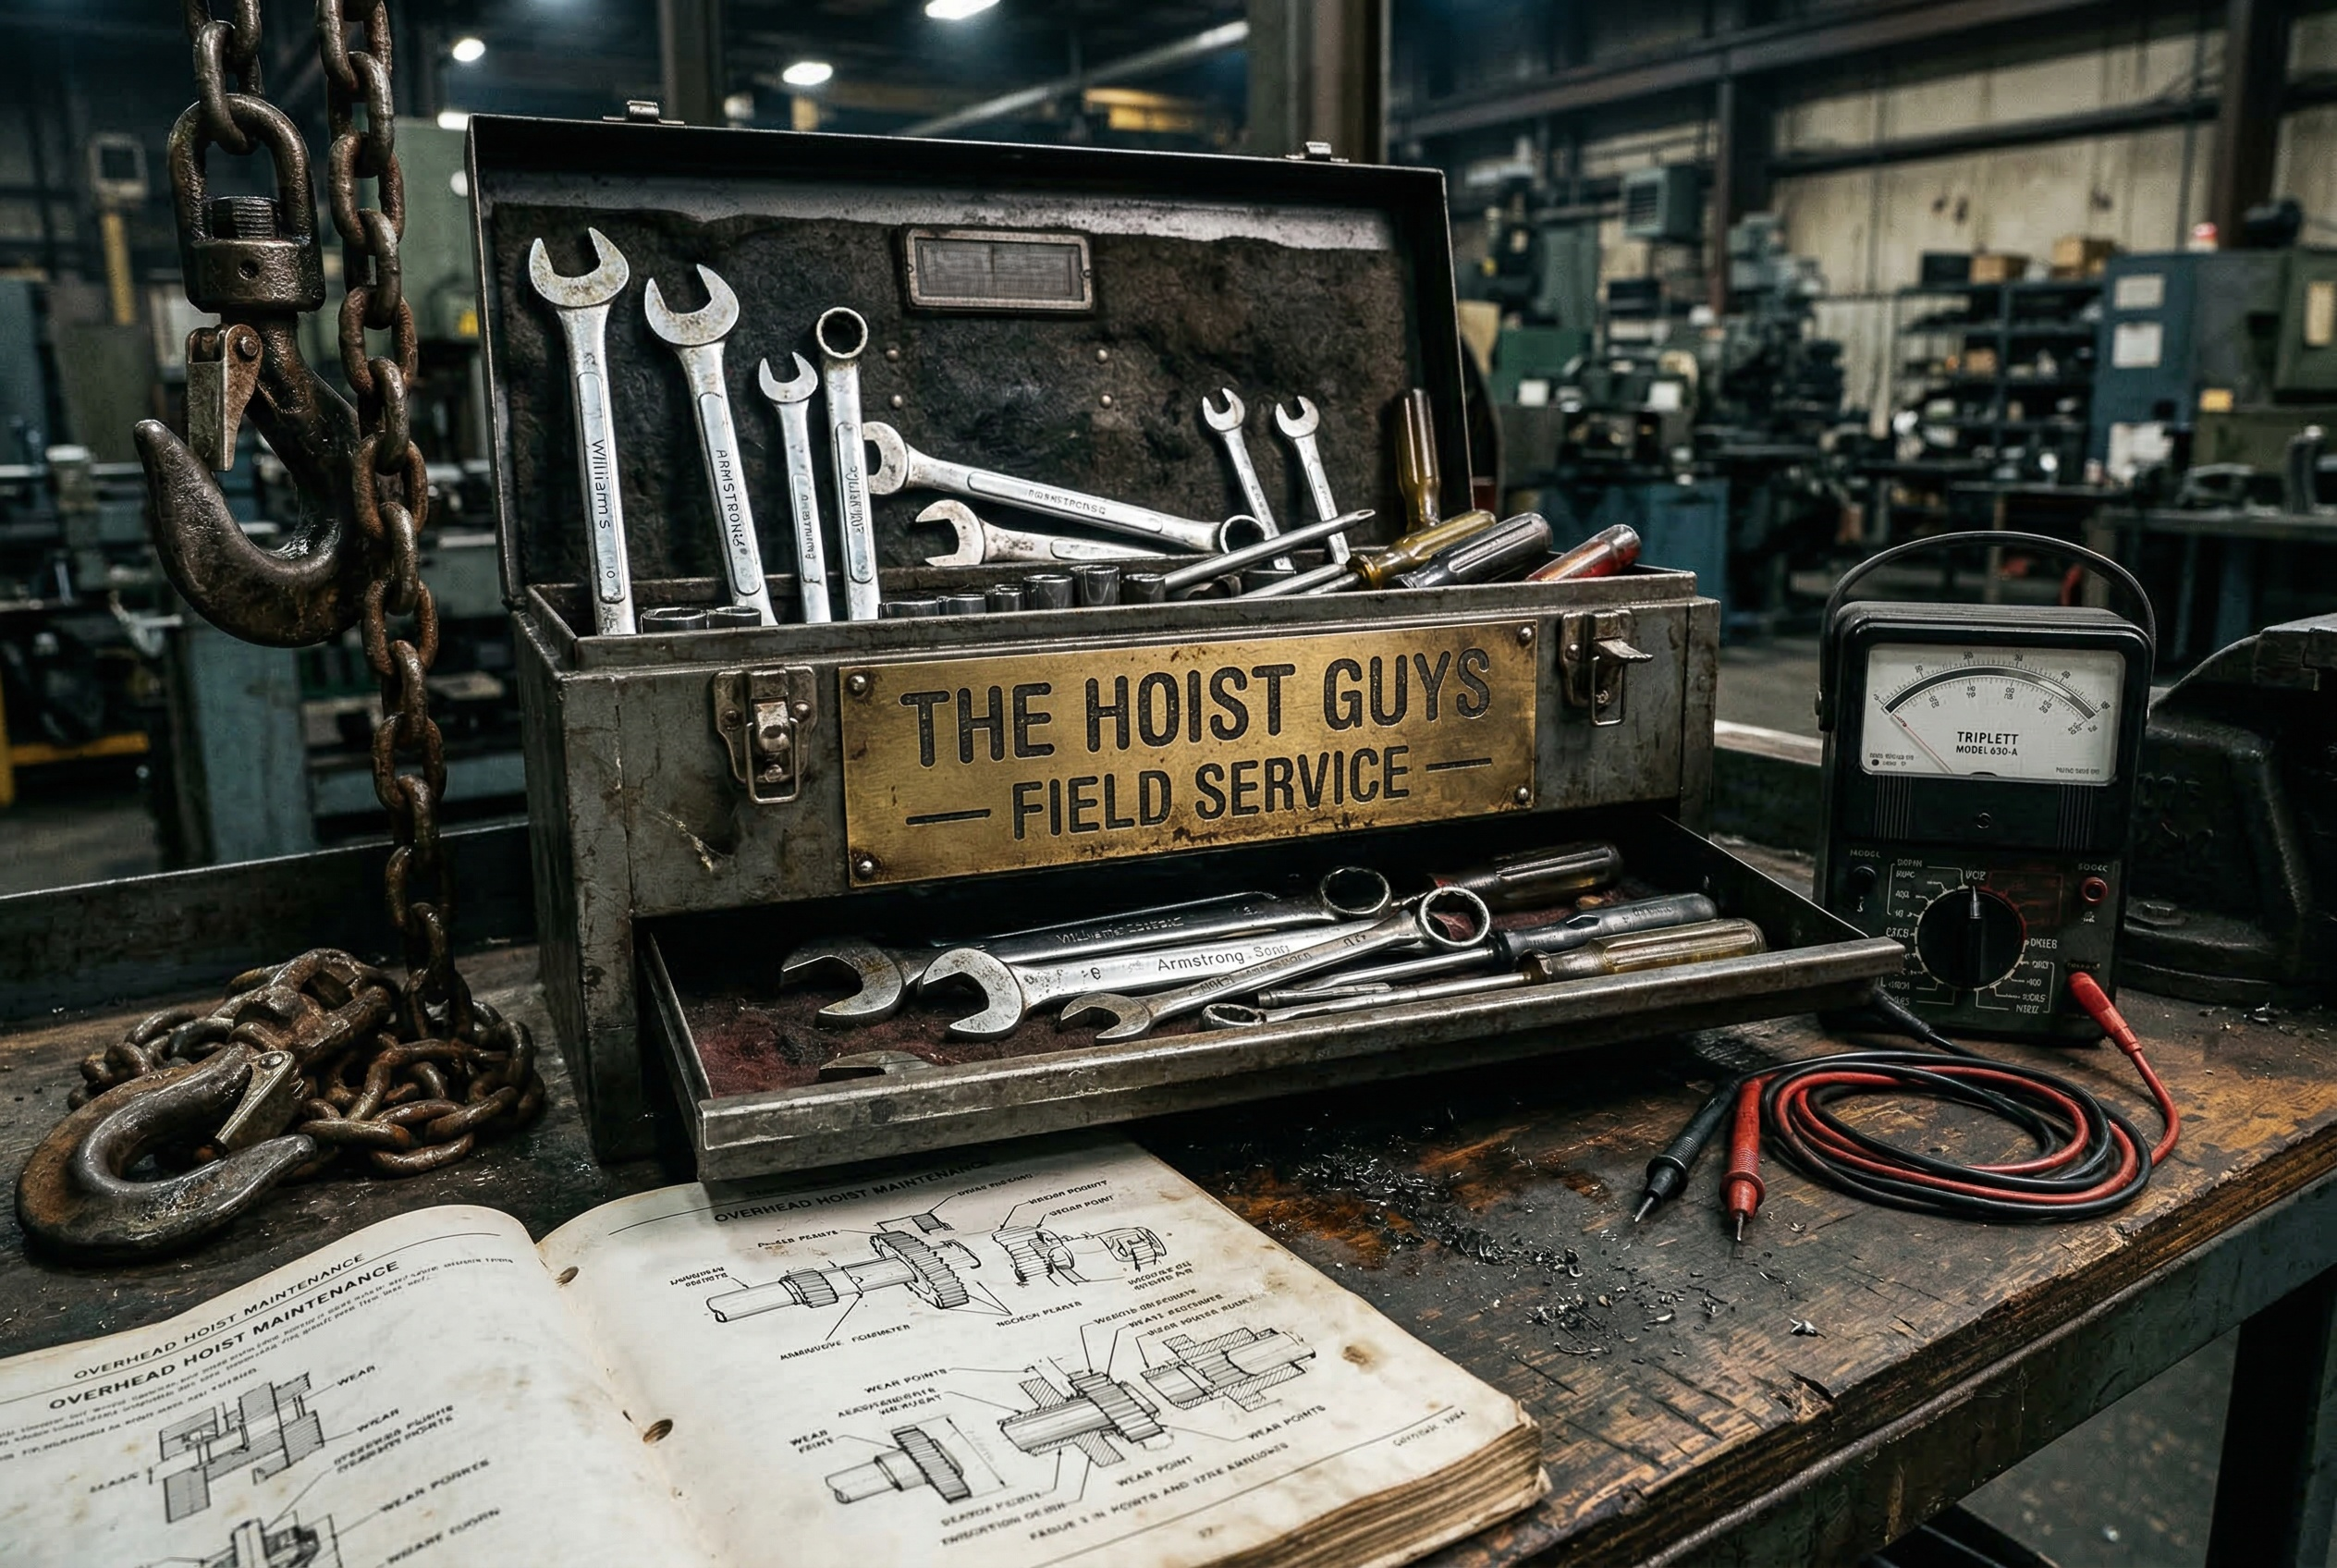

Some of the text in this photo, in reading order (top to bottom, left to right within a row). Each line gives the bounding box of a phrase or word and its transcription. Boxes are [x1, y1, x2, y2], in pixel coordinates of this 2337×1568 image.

[899, 648, 1491, 769] THE HOIST GUYS
[1956, 745, 2018, 756] MODEL 630-A
[1957, 731, 2019, 744] TRIPLETT
[1012, 745, 1412, 841] FIELD SERVICE
[1156, 950, 1245, 972] Armstrong
[714, 1199, 813, 1223] OVERHEAD
[816, 1188, 867, 1209] HOIST
[874, 1158, 992, 1194] MAINTENANCE
[49, 1364, 177, 1410] OVERHEAD
[183, 1332, 246, 1367] HOIST
[252, 1260, 400, 1336] MAINTENANCE
[74, 1252, 365, 1379] OVERHEAD HOIST MAINTENANCE
[336, 1365, 376, 1387] WEAR
[1116, 1455, 1194, 1488] WEAR POINT
